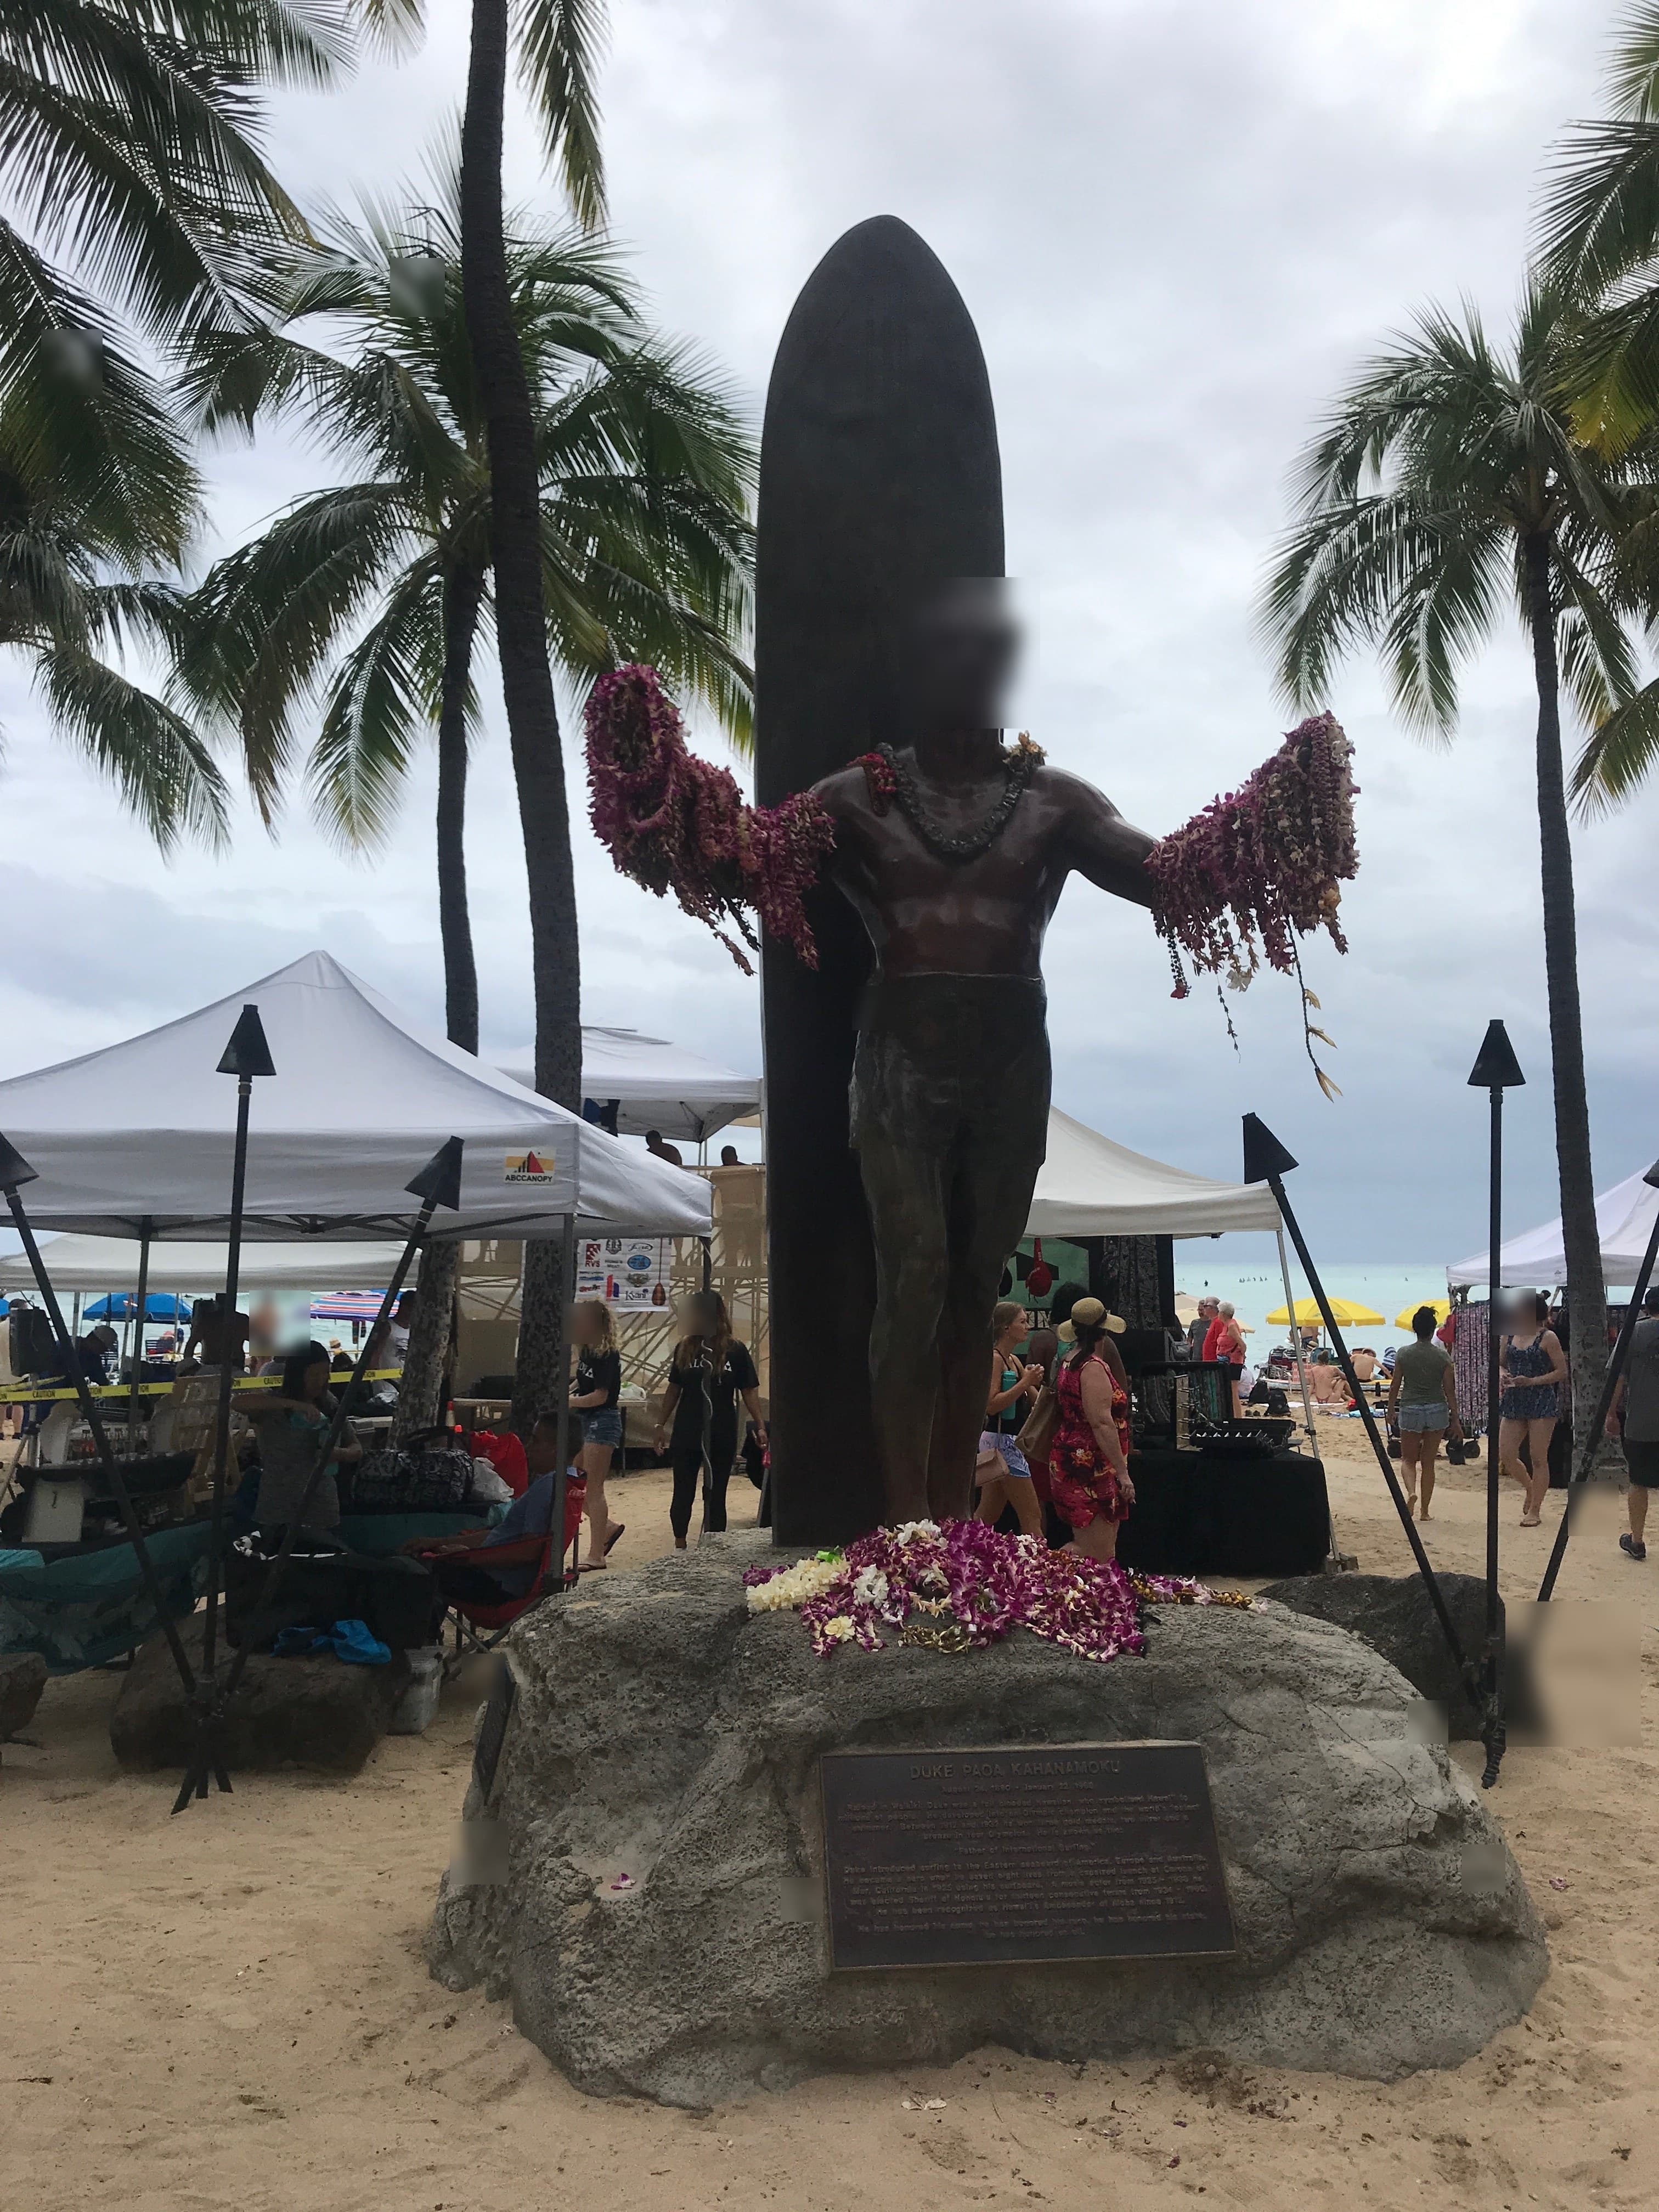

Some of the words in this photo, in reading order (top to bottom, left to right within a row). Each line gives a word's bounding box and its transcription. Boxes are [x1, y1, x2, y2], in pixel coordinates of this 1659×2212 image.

[505, 1174, 552, 1182] ABCCANOPY
[585, 1260, 600, 1268] RVS
[32, 1390, 56, 1398] CAUTION
[910, 1764, 953, 1780] DUKE
[962, 1763, 1004, 1778] PAOA
[1010, 1759, 1119, 1777] KAHANAMOKU
